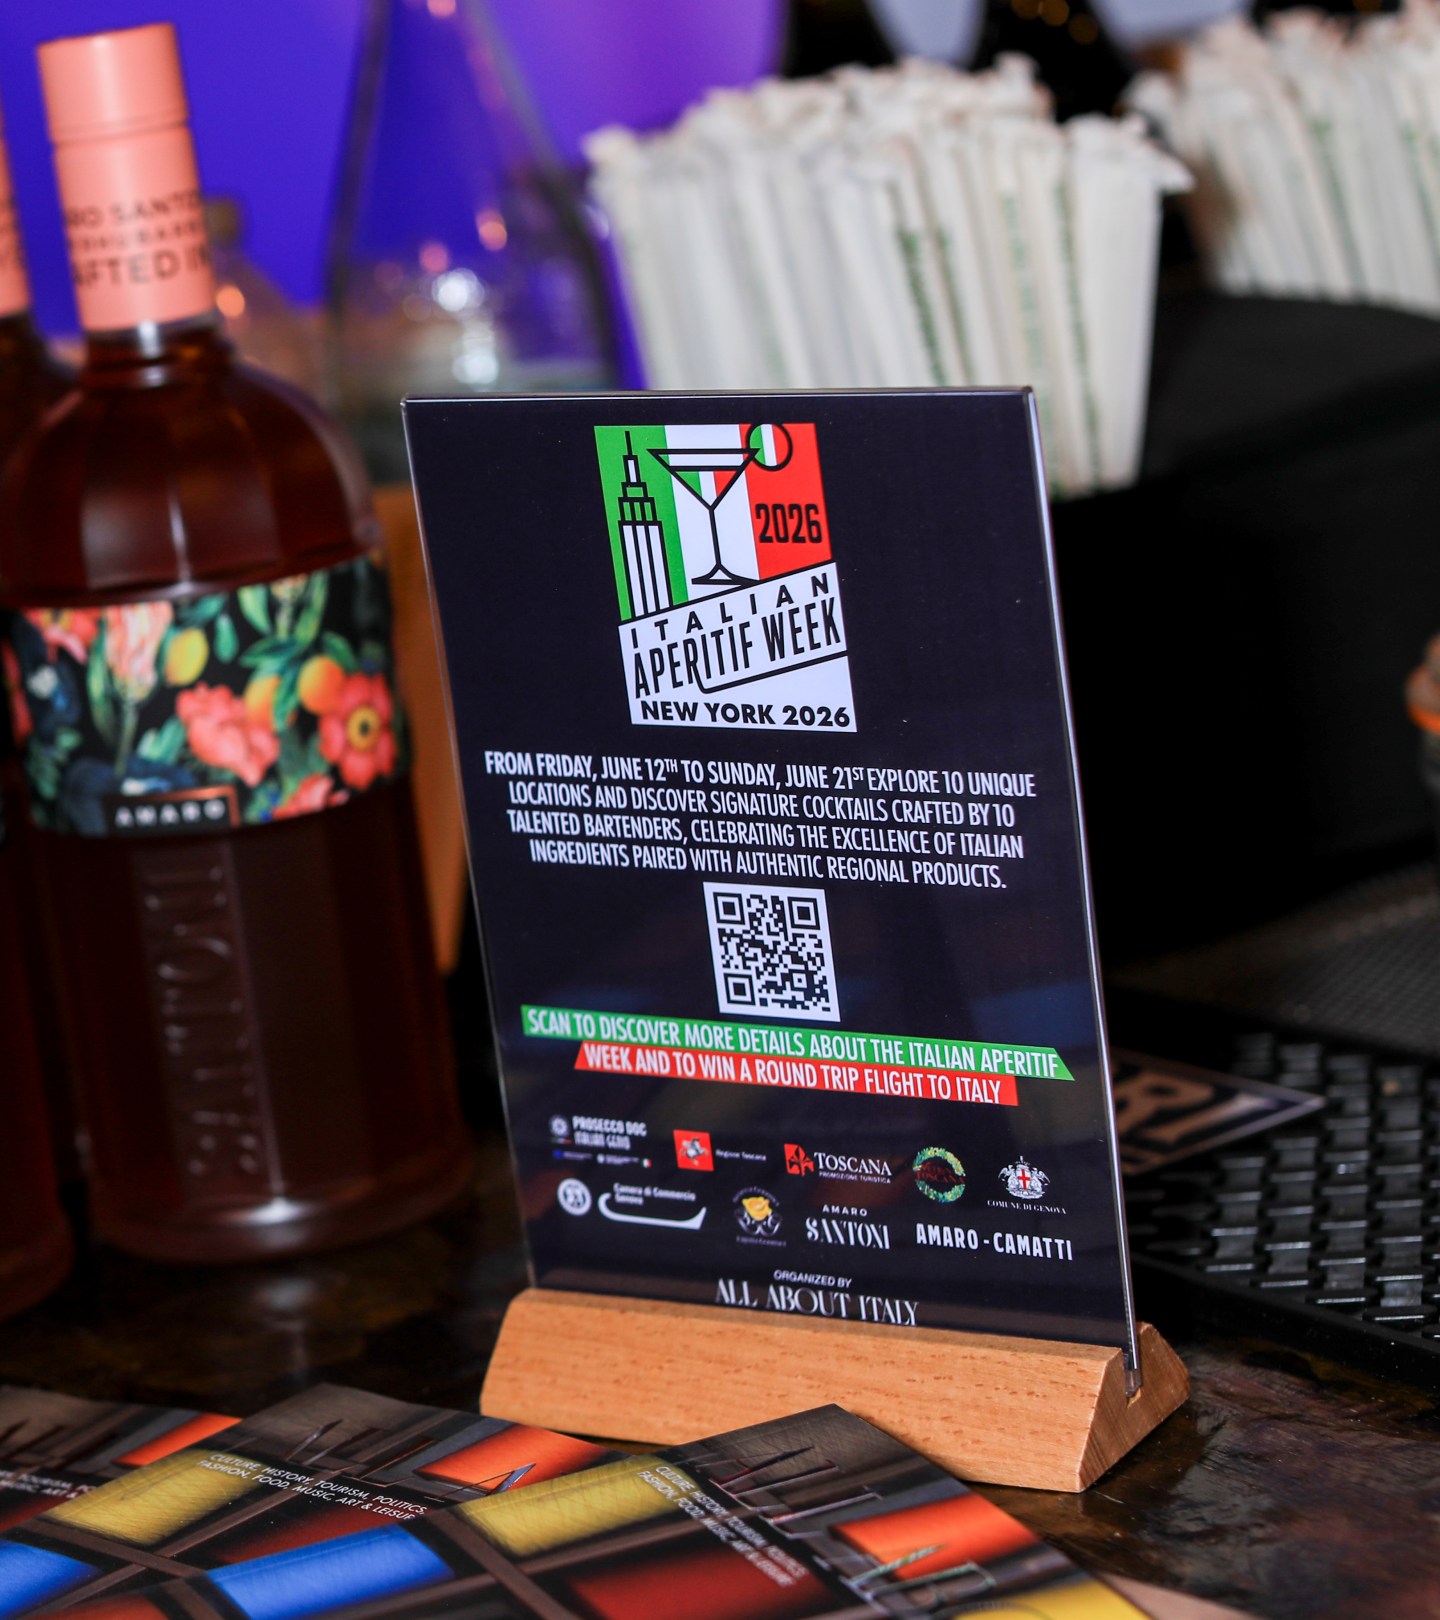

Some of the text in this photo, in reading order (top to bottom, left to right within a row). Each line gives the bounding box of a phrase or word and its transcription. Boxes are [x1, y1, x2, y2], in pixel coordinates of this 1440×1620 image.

[755, 503, 822, 543] 2026
[631, 572, 829, 649] ITALIAN
[634, 597, 840, 699] APERITIF WEEK
[640, 700, 850, 727] NEW YORK 2026
[484, 750, 534, 776] FROM
[536, 753, 597, 783] FRIDAY,
[600, 756, 643, 781] JUNE
[681, 760, 704, 783] TO
[707, 761, 781, 790] SUNDAY,
[784, 765, 829, 789] JUNE
[867, 768, 940, 794] EXPLORE
[942, 771, 964, 795] 10
[968, 772, 1036, 797] UNIQUE
[508, 781, 1015, 827] LOCATIONS AND DISCOVER SIGNATURE COCKTAILS CRAFTED BY 10
[507, 809, 1024, 859] TALENTED BARTENDERS, CELEBRATING THE EXCELLENCE OF ITALIAN
[529, 839, 1007, 889] INGREDIENTS PAIRED WITH AUTHENTIC REGIONAL PRODUCTS.
[527, 1008, 1059, 1078] SCAN TO DISCOVER MORE DETAILS ABOUT THE ITALIAN APERITIF
[584, 1043, 1001, 1104] WEEK AND TO WIN A ROUND TRIP FLIGHT TO ITALY
[813, 1152, 892, 1176] TOSCANA
[819, 1171, 891, 1184] PROMOZIONE TURISTICA
[822, 1204, 867, 1217] AMARO
[987, 1200, 1067, 1215] COMUNE DI GENOVA
[805, 1217, 890, 1250] SANTONI
[715, 1277, 919, 1326] ALL ABOUT ITALY
[773, 1269, 852, 1288] ORGANIZED BY
[252, 1473, 289, 1490] FOOD,
[292, 1486, 333, 1501] MUSIC,
[336, 1496, 362, 1506] ART
[372, 1505, 416, 1520] LEISUR
[314, 1480, 368, 1501] TOURISM,
[372, 1495, 428, 1515] POLITICS,
